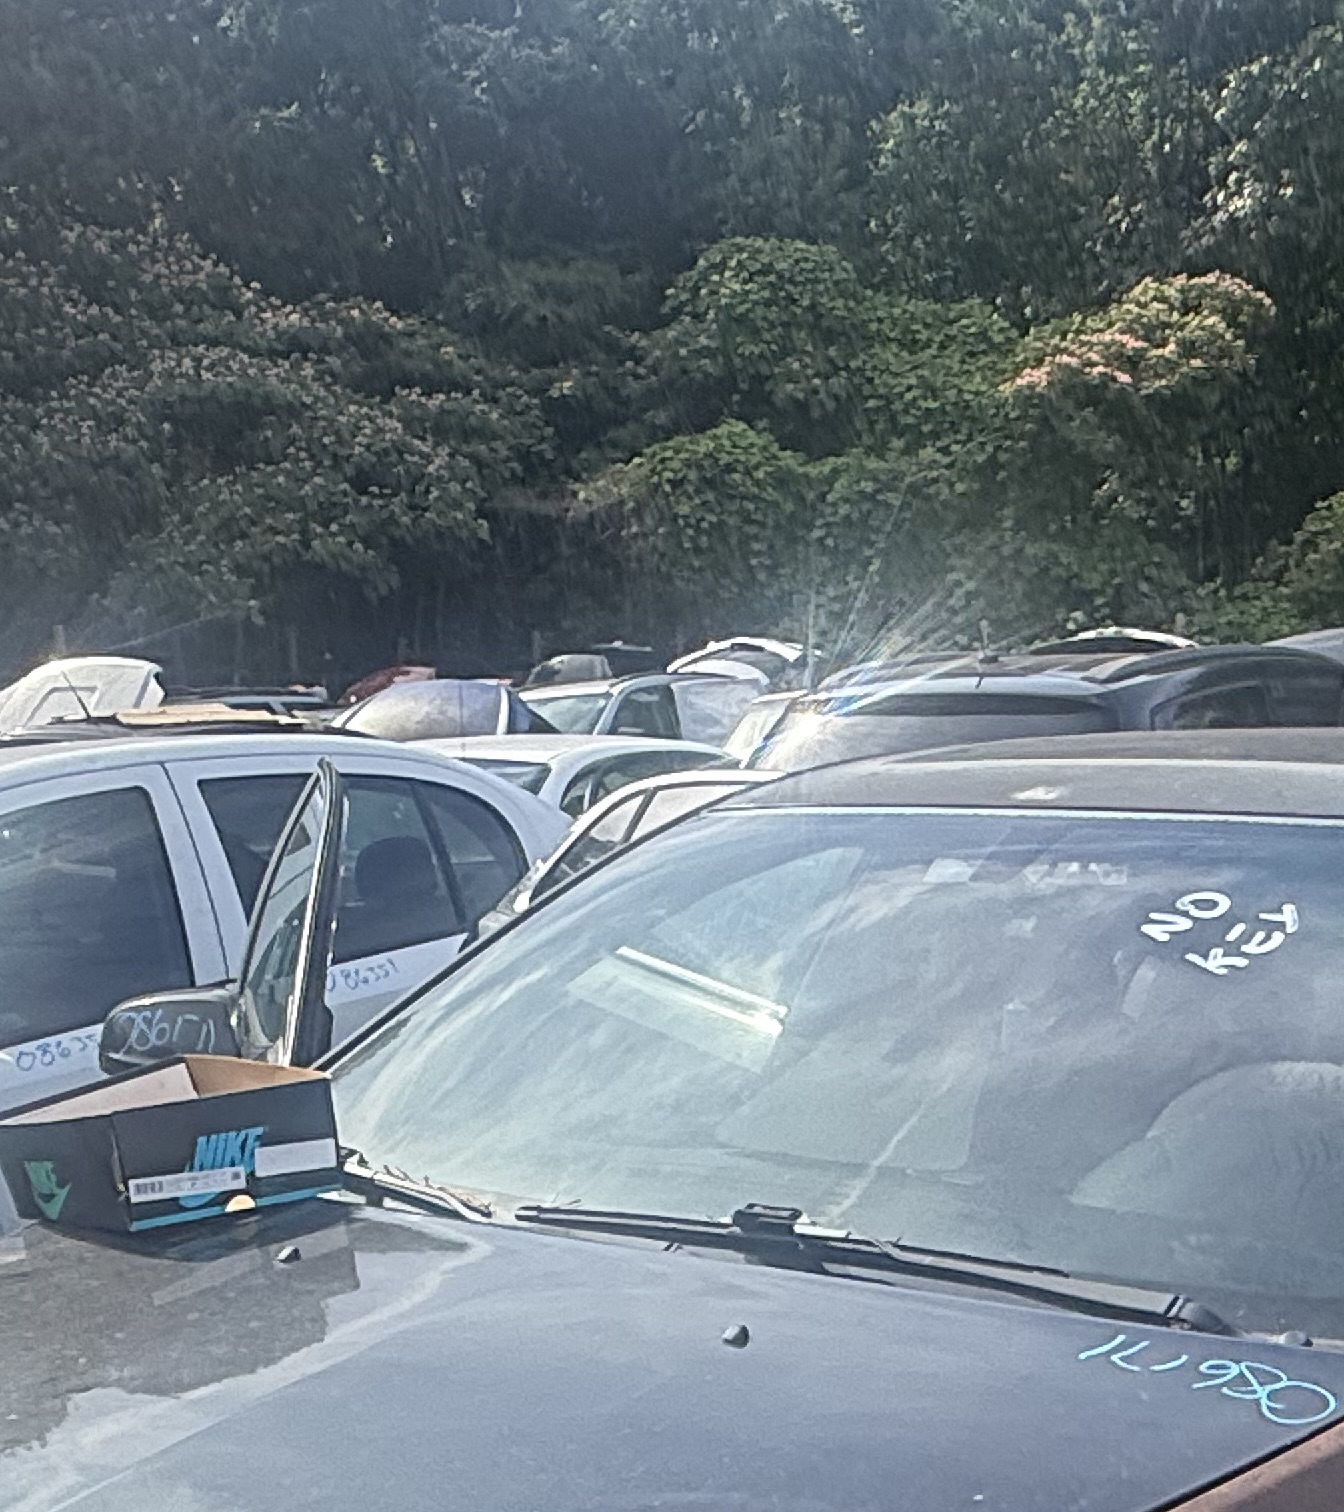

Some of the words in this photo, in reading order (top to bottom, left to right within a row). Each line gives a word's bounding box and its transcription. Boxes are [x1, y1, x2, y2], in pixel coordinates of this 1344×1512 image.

[1140, 890, 1232, 942] NO
[1185, 902, 1300, 976] KEY
[197, 1126, 264, 1173] NIKE
